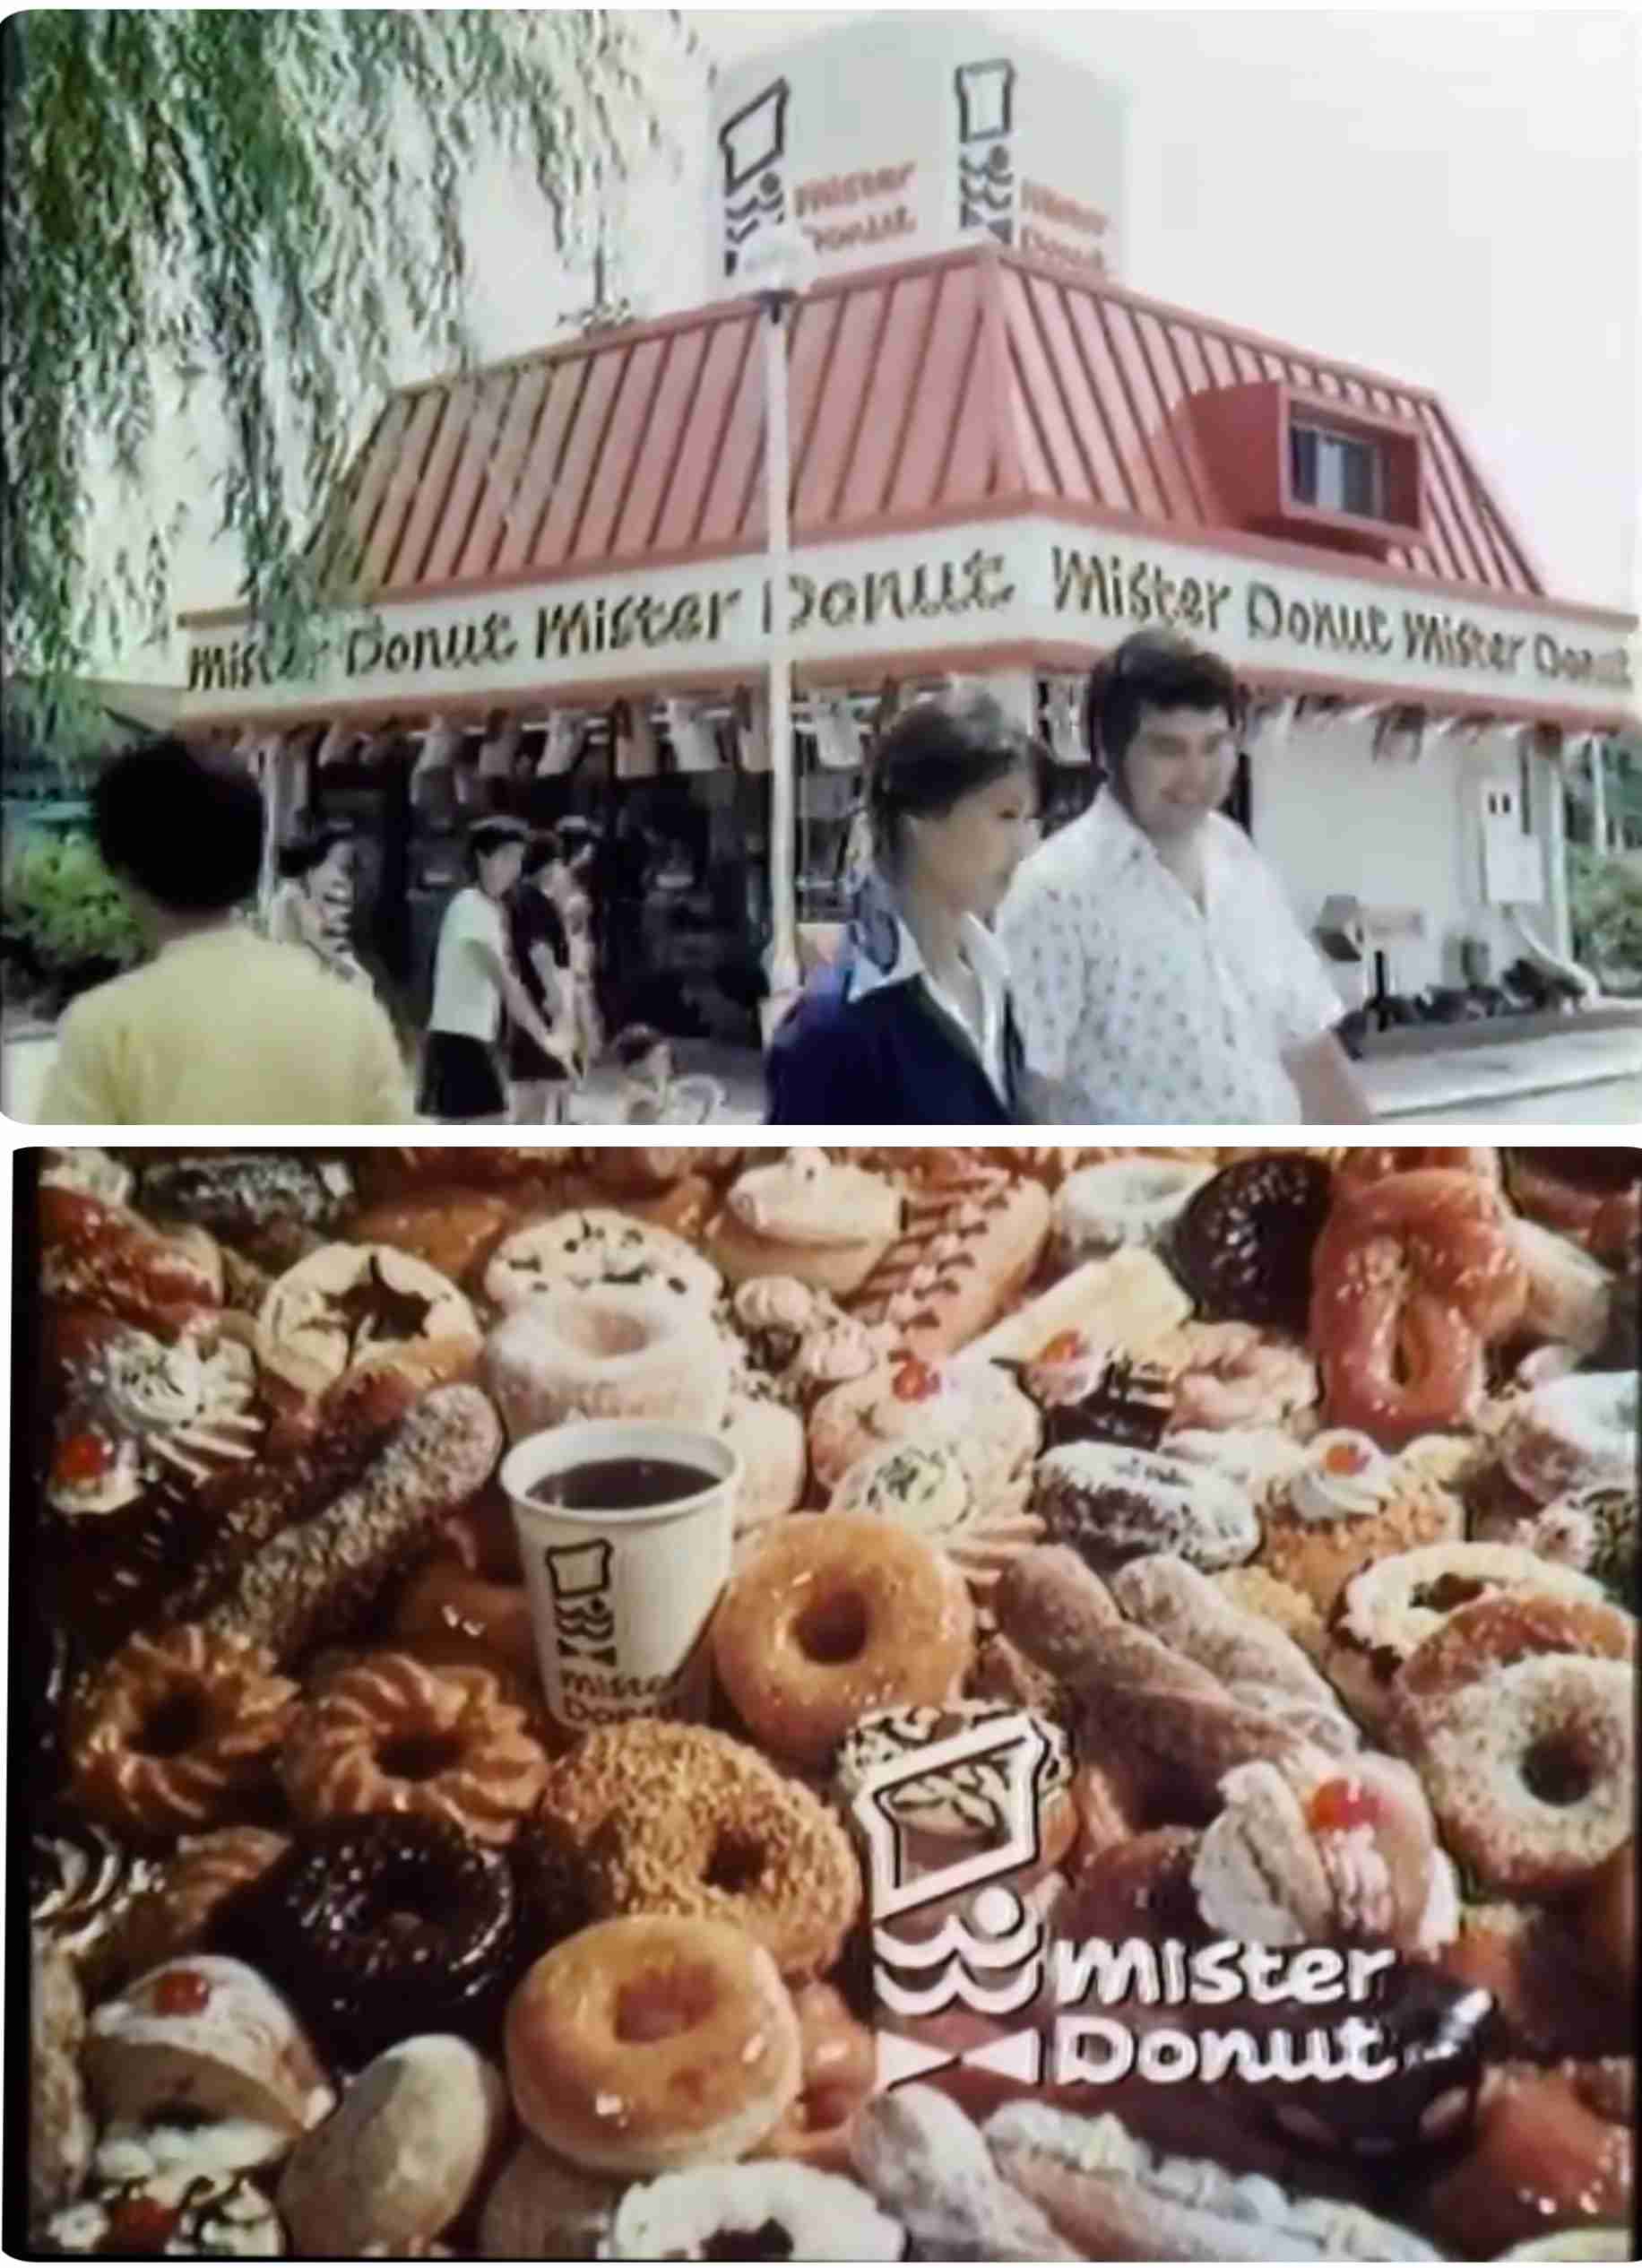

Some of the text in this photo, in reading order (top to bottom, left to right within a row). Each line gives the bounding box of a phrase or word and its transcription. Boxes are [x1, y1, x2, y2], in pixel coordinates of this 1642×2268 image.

[801, 205, 917, 255] onut
[346, 611, 518, 677] Donut
[535, 589, 742, 659] Mister
[1051, 546, 1232, 630] Mister
[1247, 580, 1393, 655] Donut
[1404, 610, 1523, 672] Mister
